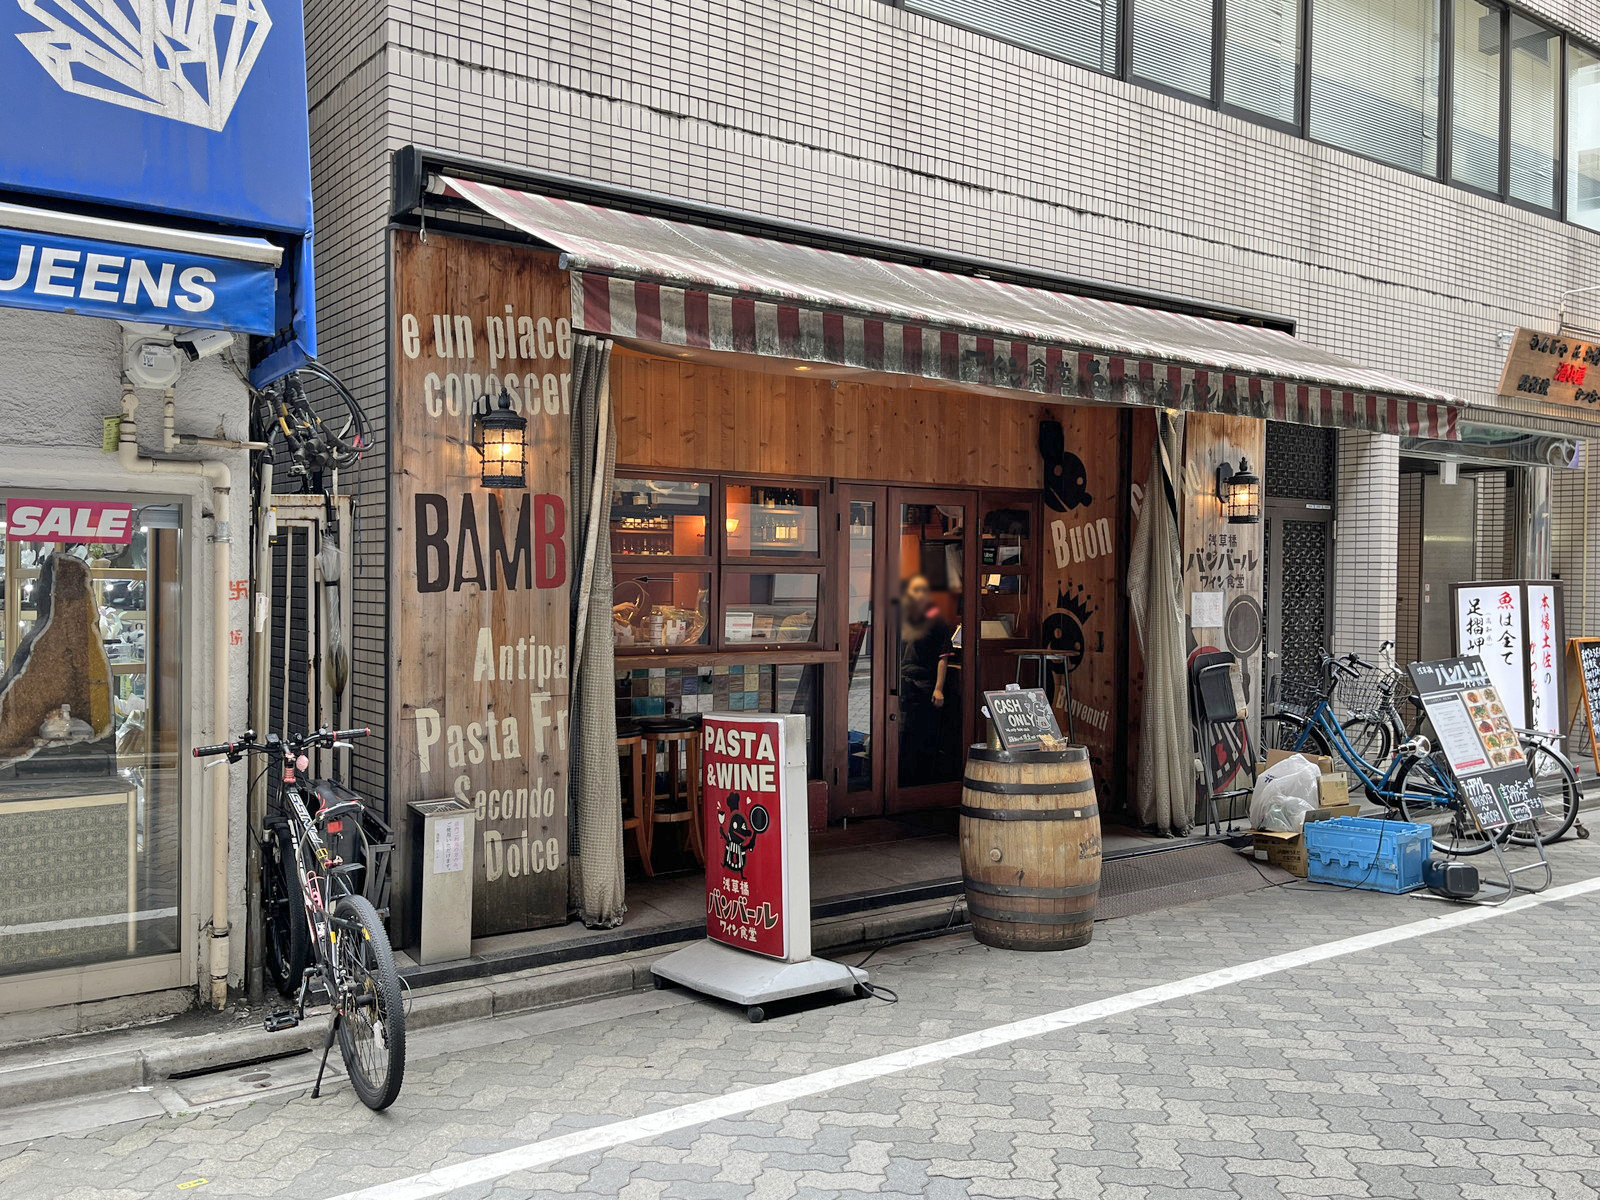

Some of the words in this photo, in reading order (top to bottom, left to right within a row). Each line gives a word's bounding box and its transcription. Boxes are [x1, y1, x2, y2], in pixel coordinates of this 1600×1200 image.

[402, 313, 420, 360] e
[434, 313, 475, 359] un
[9, 506, 131, 538] SALE
[415, 492, 566, 593] BAMB
[1051, 517, 1112, 569] Buon
[1208, 533, 1238, 548] 浅草橋
[1186, 547, 1259, 573] バンバール
[1200, 575, 1245, 589] ワイン食堂
[1466, 598, 1485, 653] 足摺岬
[1497, 591, 1516, 666] 魚は全て
[1540, 593, 1552, 685] 本場土佐の
[473, 627, 567, 688] Antipa
[994, 699, 1023, 714] CASH
[1007, 713, 1036, 727] ONLY
[415, 707, 521, 773] Pasta
[705, 725, 776, 762] PASTA
[453, 774, 556, 822] Secondo
[484, 829, 560, 882] Dolce
[722, 876, 750, 896] 浅草橋
[708, 888, 779, 930] バンバール
[719, 920, 757, 942] ワイン食堂
